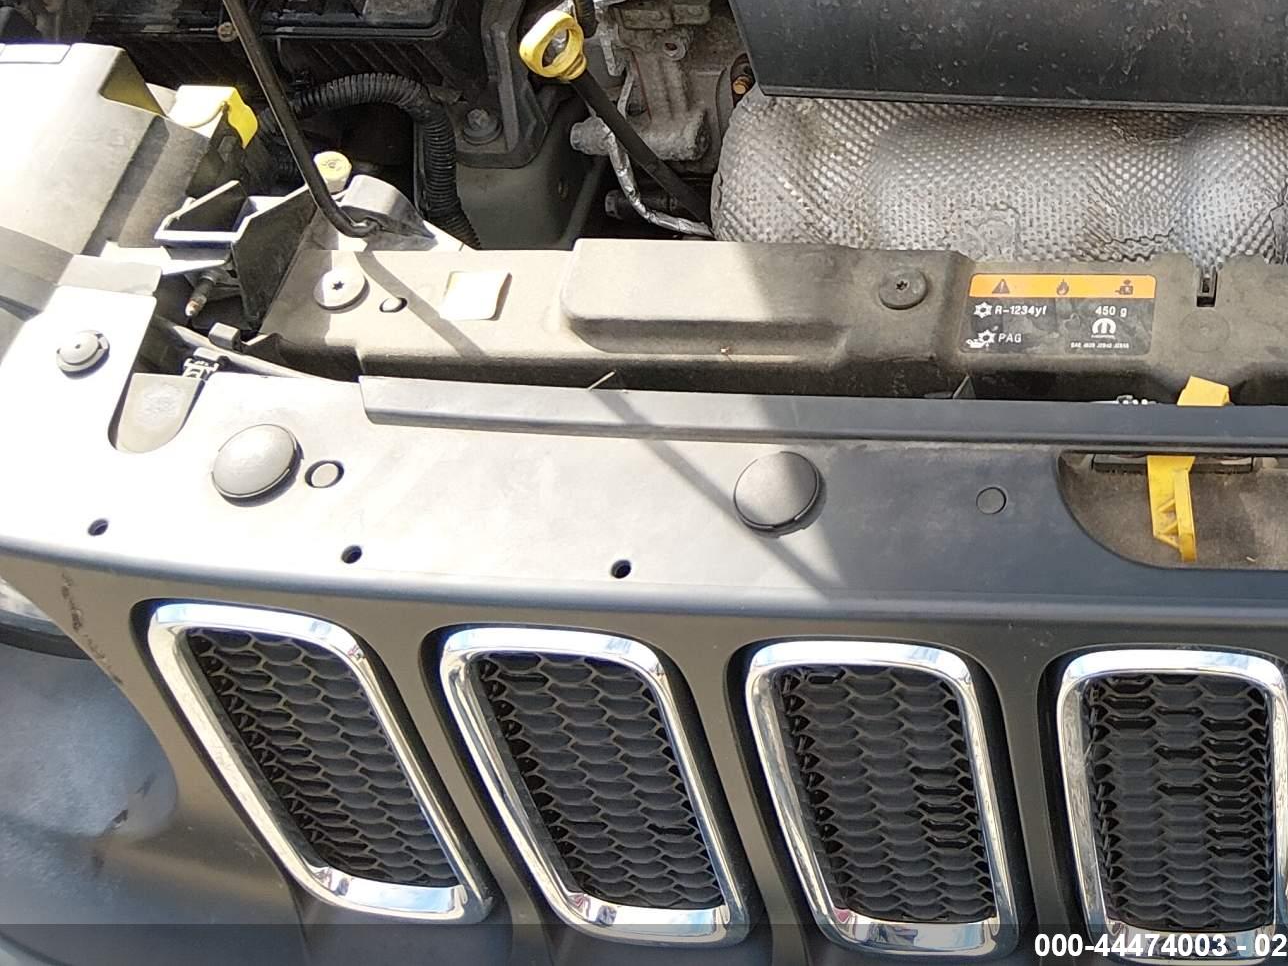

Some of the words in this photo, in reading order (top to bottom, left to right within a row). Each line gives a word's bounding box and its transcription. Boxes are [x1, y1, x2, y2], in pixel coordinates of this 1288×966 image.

[994, 305, 1047, 317] R-1234yf
[1095, 305, 1116, 316] 450
[1119, 307, 1128, 318] g
[998, 333, 1022, 343] PAG
